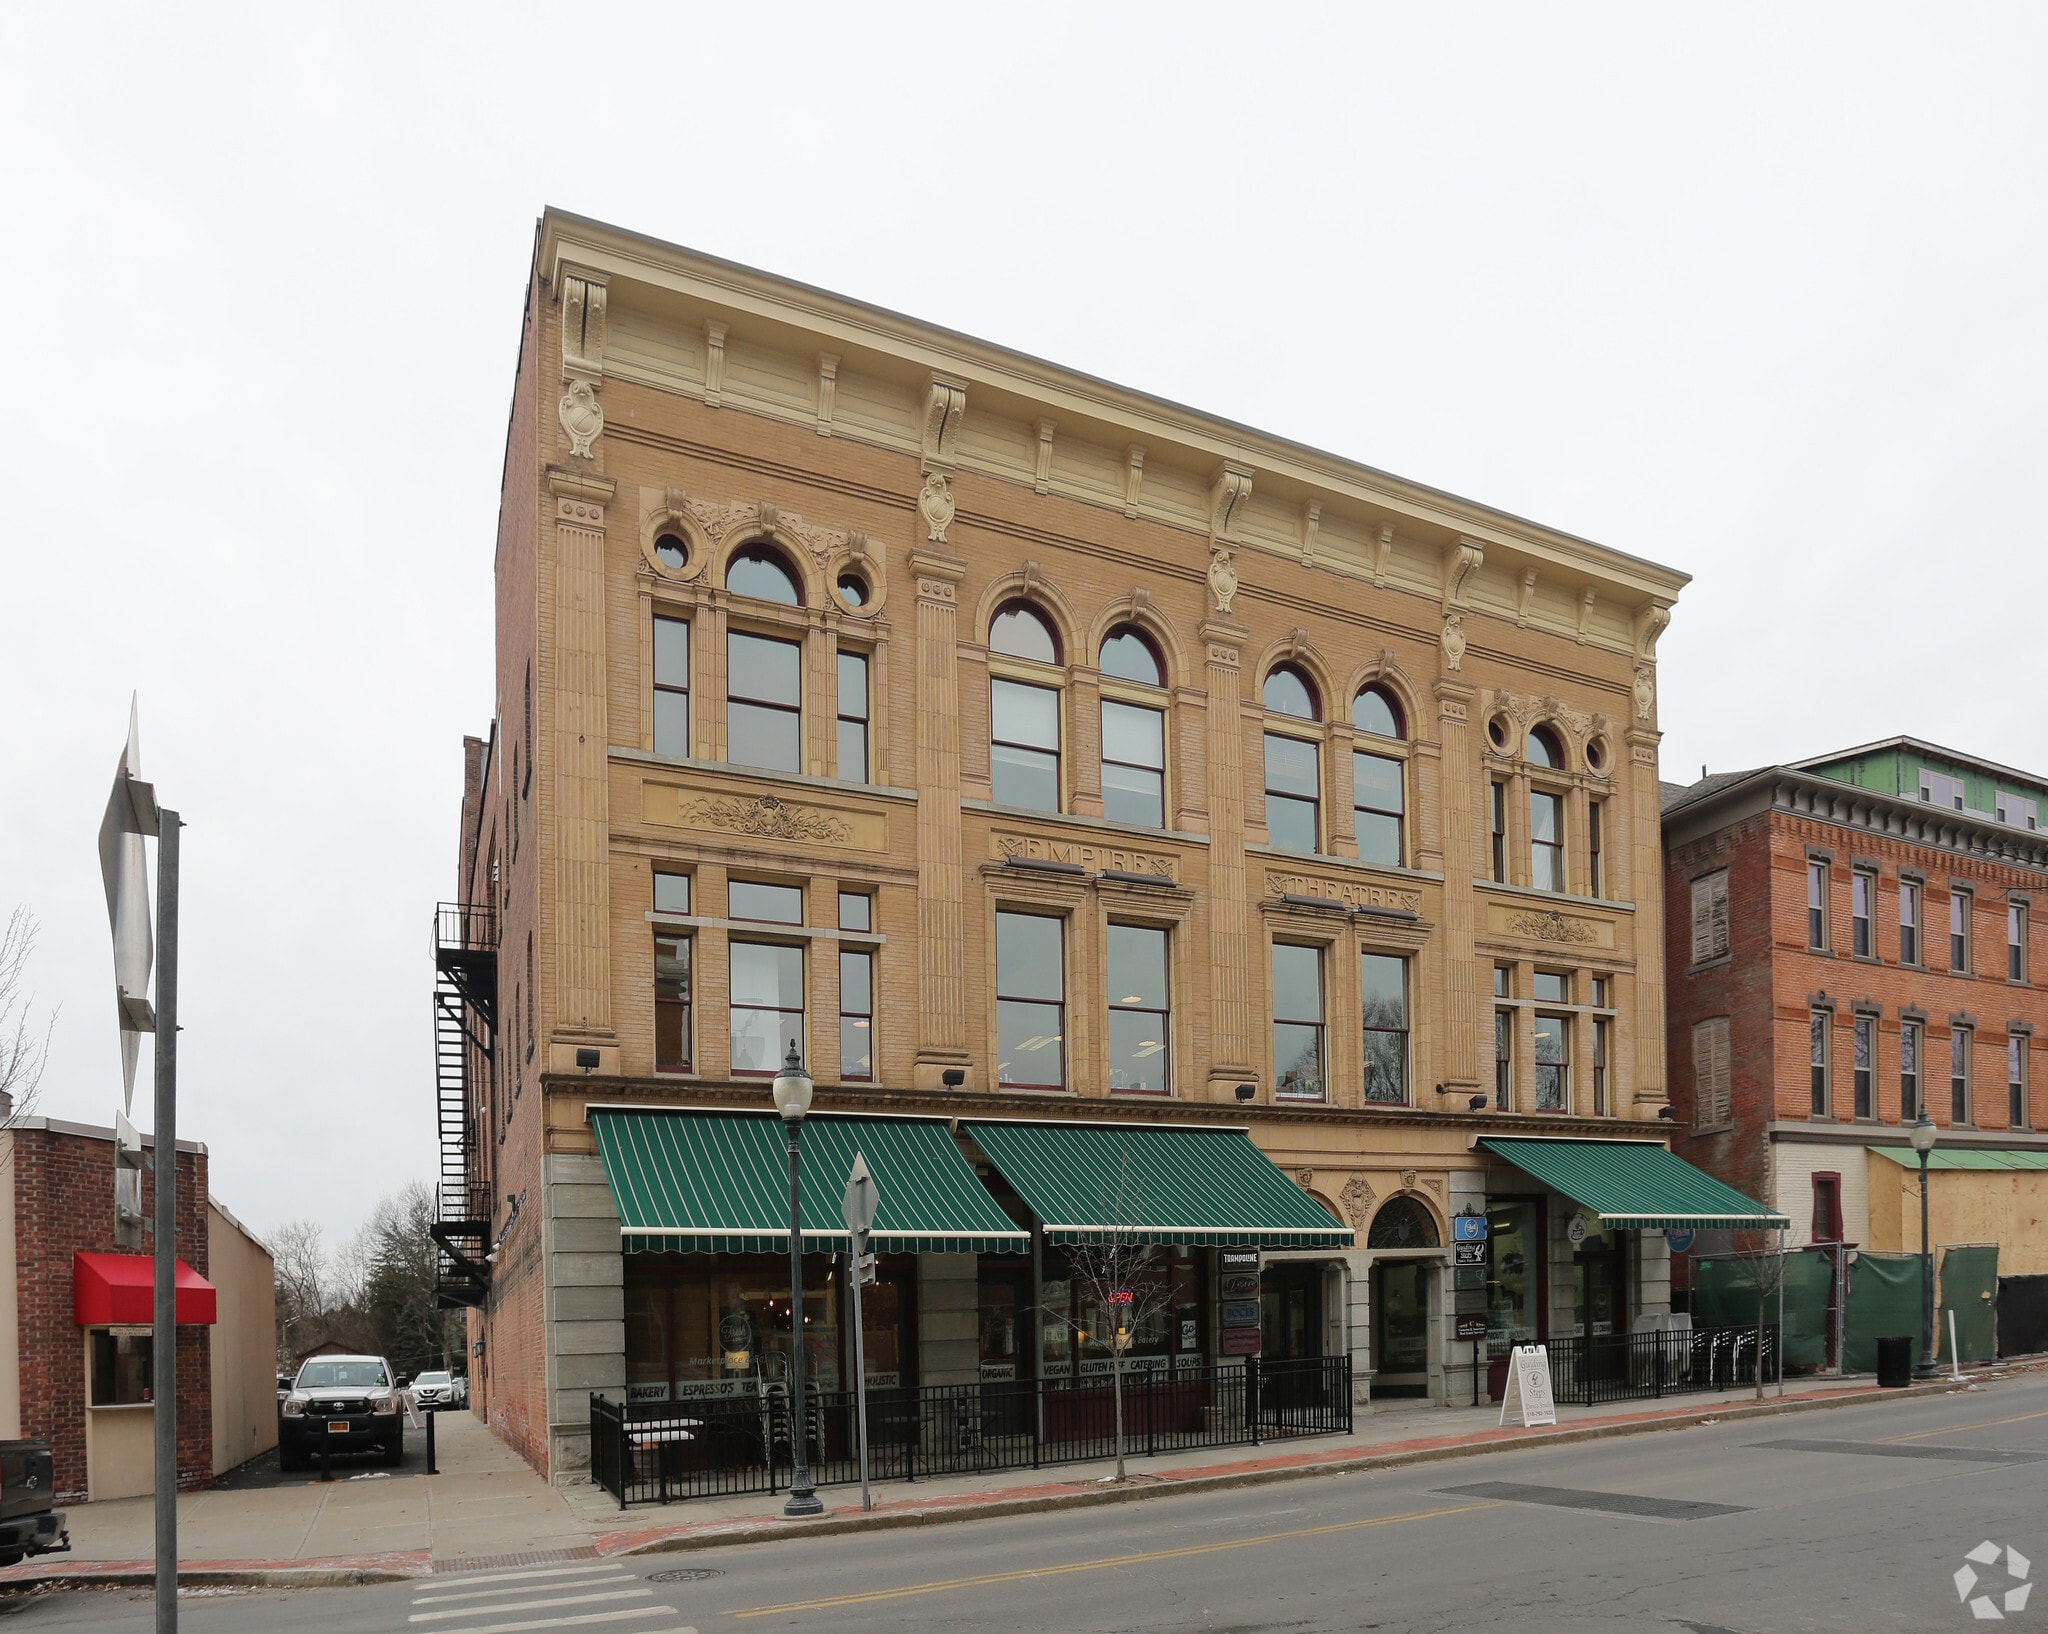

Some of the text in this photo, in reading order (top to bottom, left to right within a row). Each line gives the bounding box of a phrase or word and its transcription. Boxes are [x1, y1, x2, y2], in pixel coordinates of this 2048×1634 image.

[1024, 837, 1147, 873] EMPIRE
[1289, 876, 1398, 907] THEATRE
[1107, 1291, 1135, 1303] OPEN
[1138, 1336, 1159, 1345] Eatery
[1080, 1361, 1107, 1373] GLUTEN
[1130, 1359, 1166, 1369] CATERING
[1177, 1357, 1201, 1368] SOUPS
[982, 1367, 1013, 1379] ORGANIC
[1044, 1364, 1071, 1375] VEGAN
[864, 1375, 896, 1386] HOLISTIC
[630, 1385, 667, 1398] BAKERY
[682, 1382, 734, 1396] ESPRESSO'S
